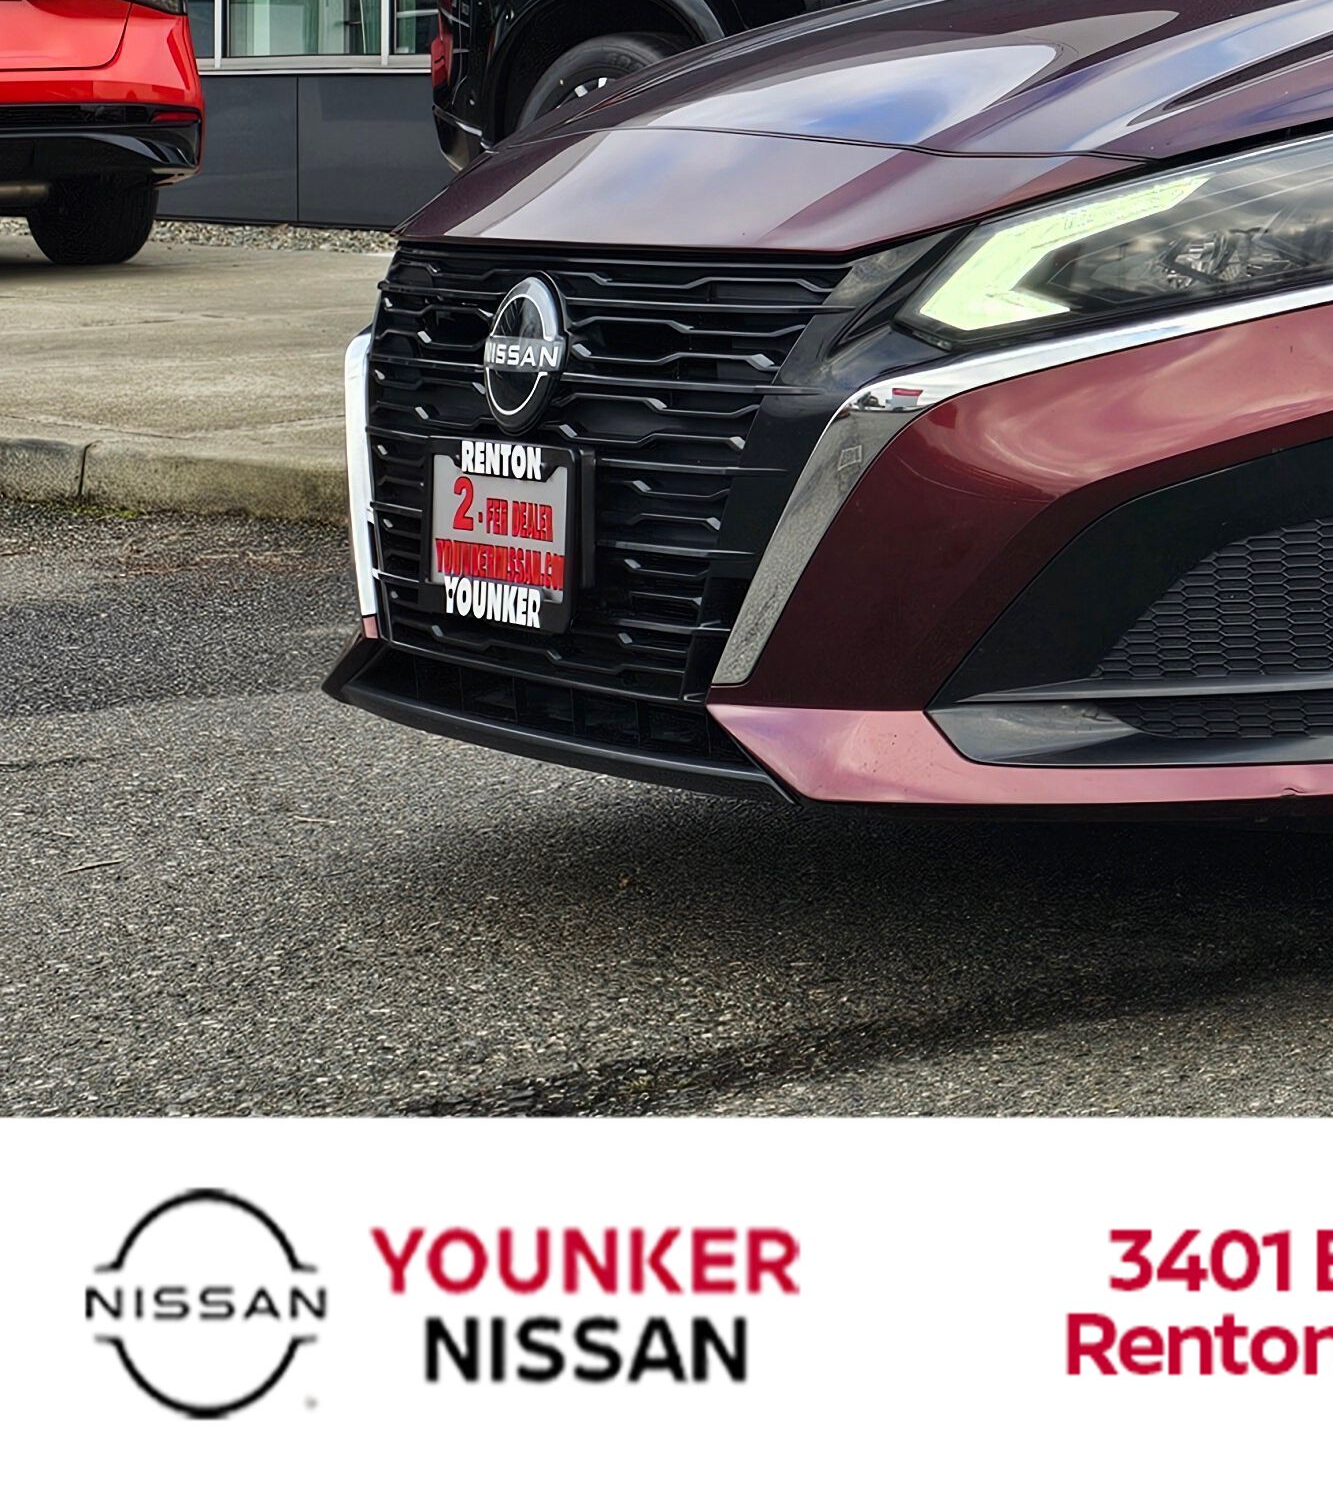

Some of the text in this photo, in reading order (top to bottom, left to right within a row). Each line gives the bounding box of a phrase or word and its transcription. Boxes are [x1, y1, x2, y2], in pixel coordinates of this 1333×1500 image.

[485, 342, 559, 368] NISSAN
[461, 440, 542, 480] RENTON
[512, 500, 553, 543] DEALER
[444, 575, 541, 629] YOUNKER
